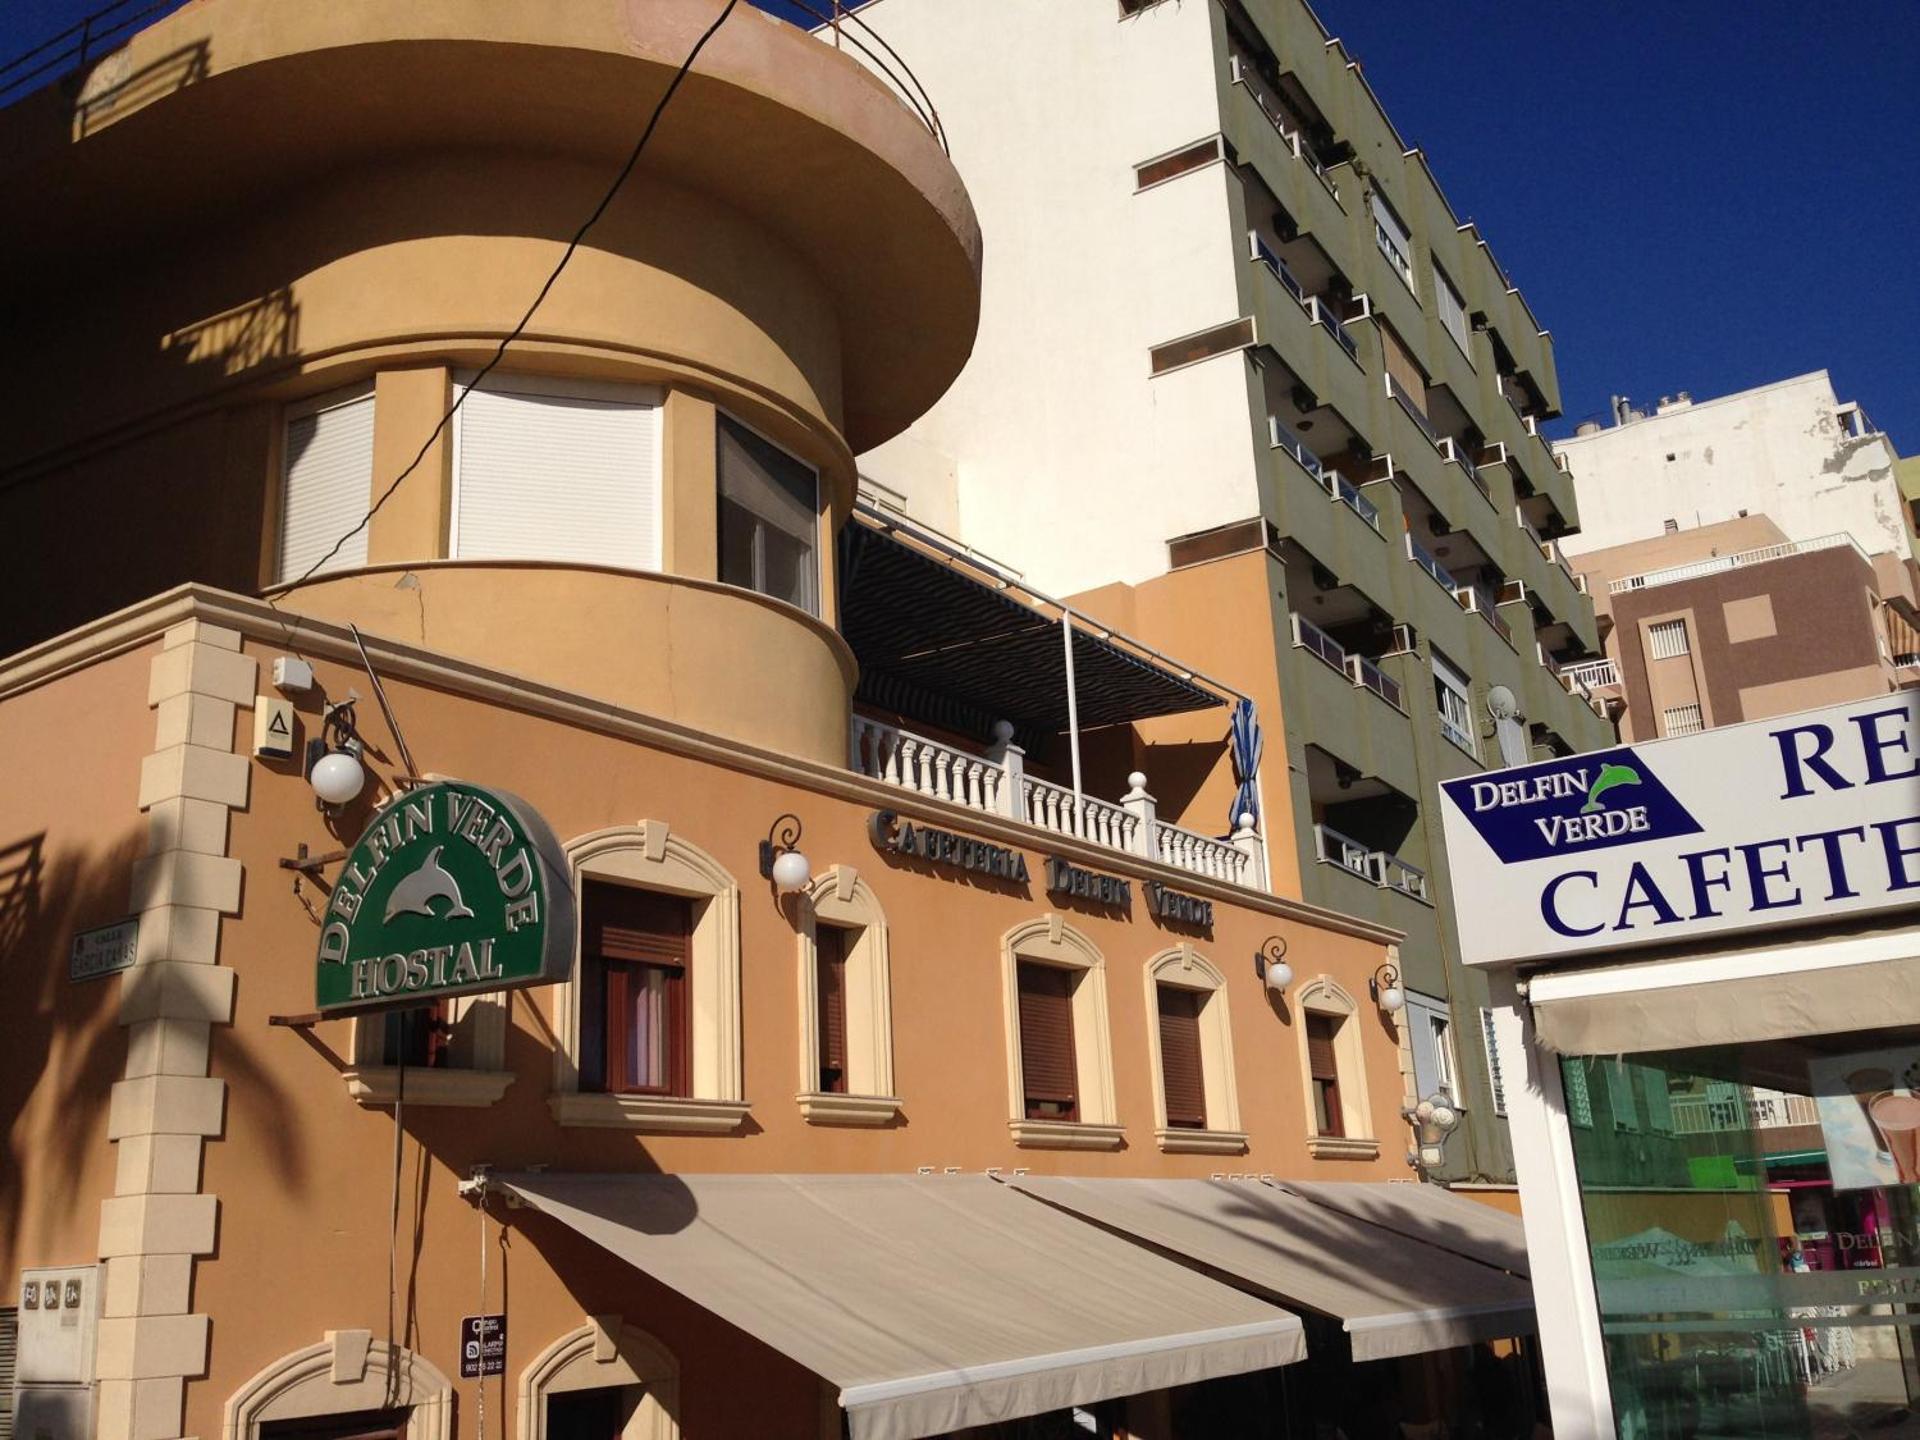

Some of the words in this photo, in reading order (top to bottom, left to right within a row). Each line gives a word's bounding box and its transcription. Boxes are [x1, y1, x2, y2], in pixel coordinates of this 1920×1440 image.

[1471, 767, 1591, 813] DELFIN
[1768, 706, 1920, 800] RE
[1535, 806, 1650, 847] VERDE
[320, 794, 434, 965] DELFIN
[447, 791, 538, 933] VERDE
[868, 808, 1030, 883] CAFETERIA
[1044, 854, 1130, 904] DELFIN
[1142, 880, 1213, 926] VERDE
[351, 938, 502, 998] HOSTAL
